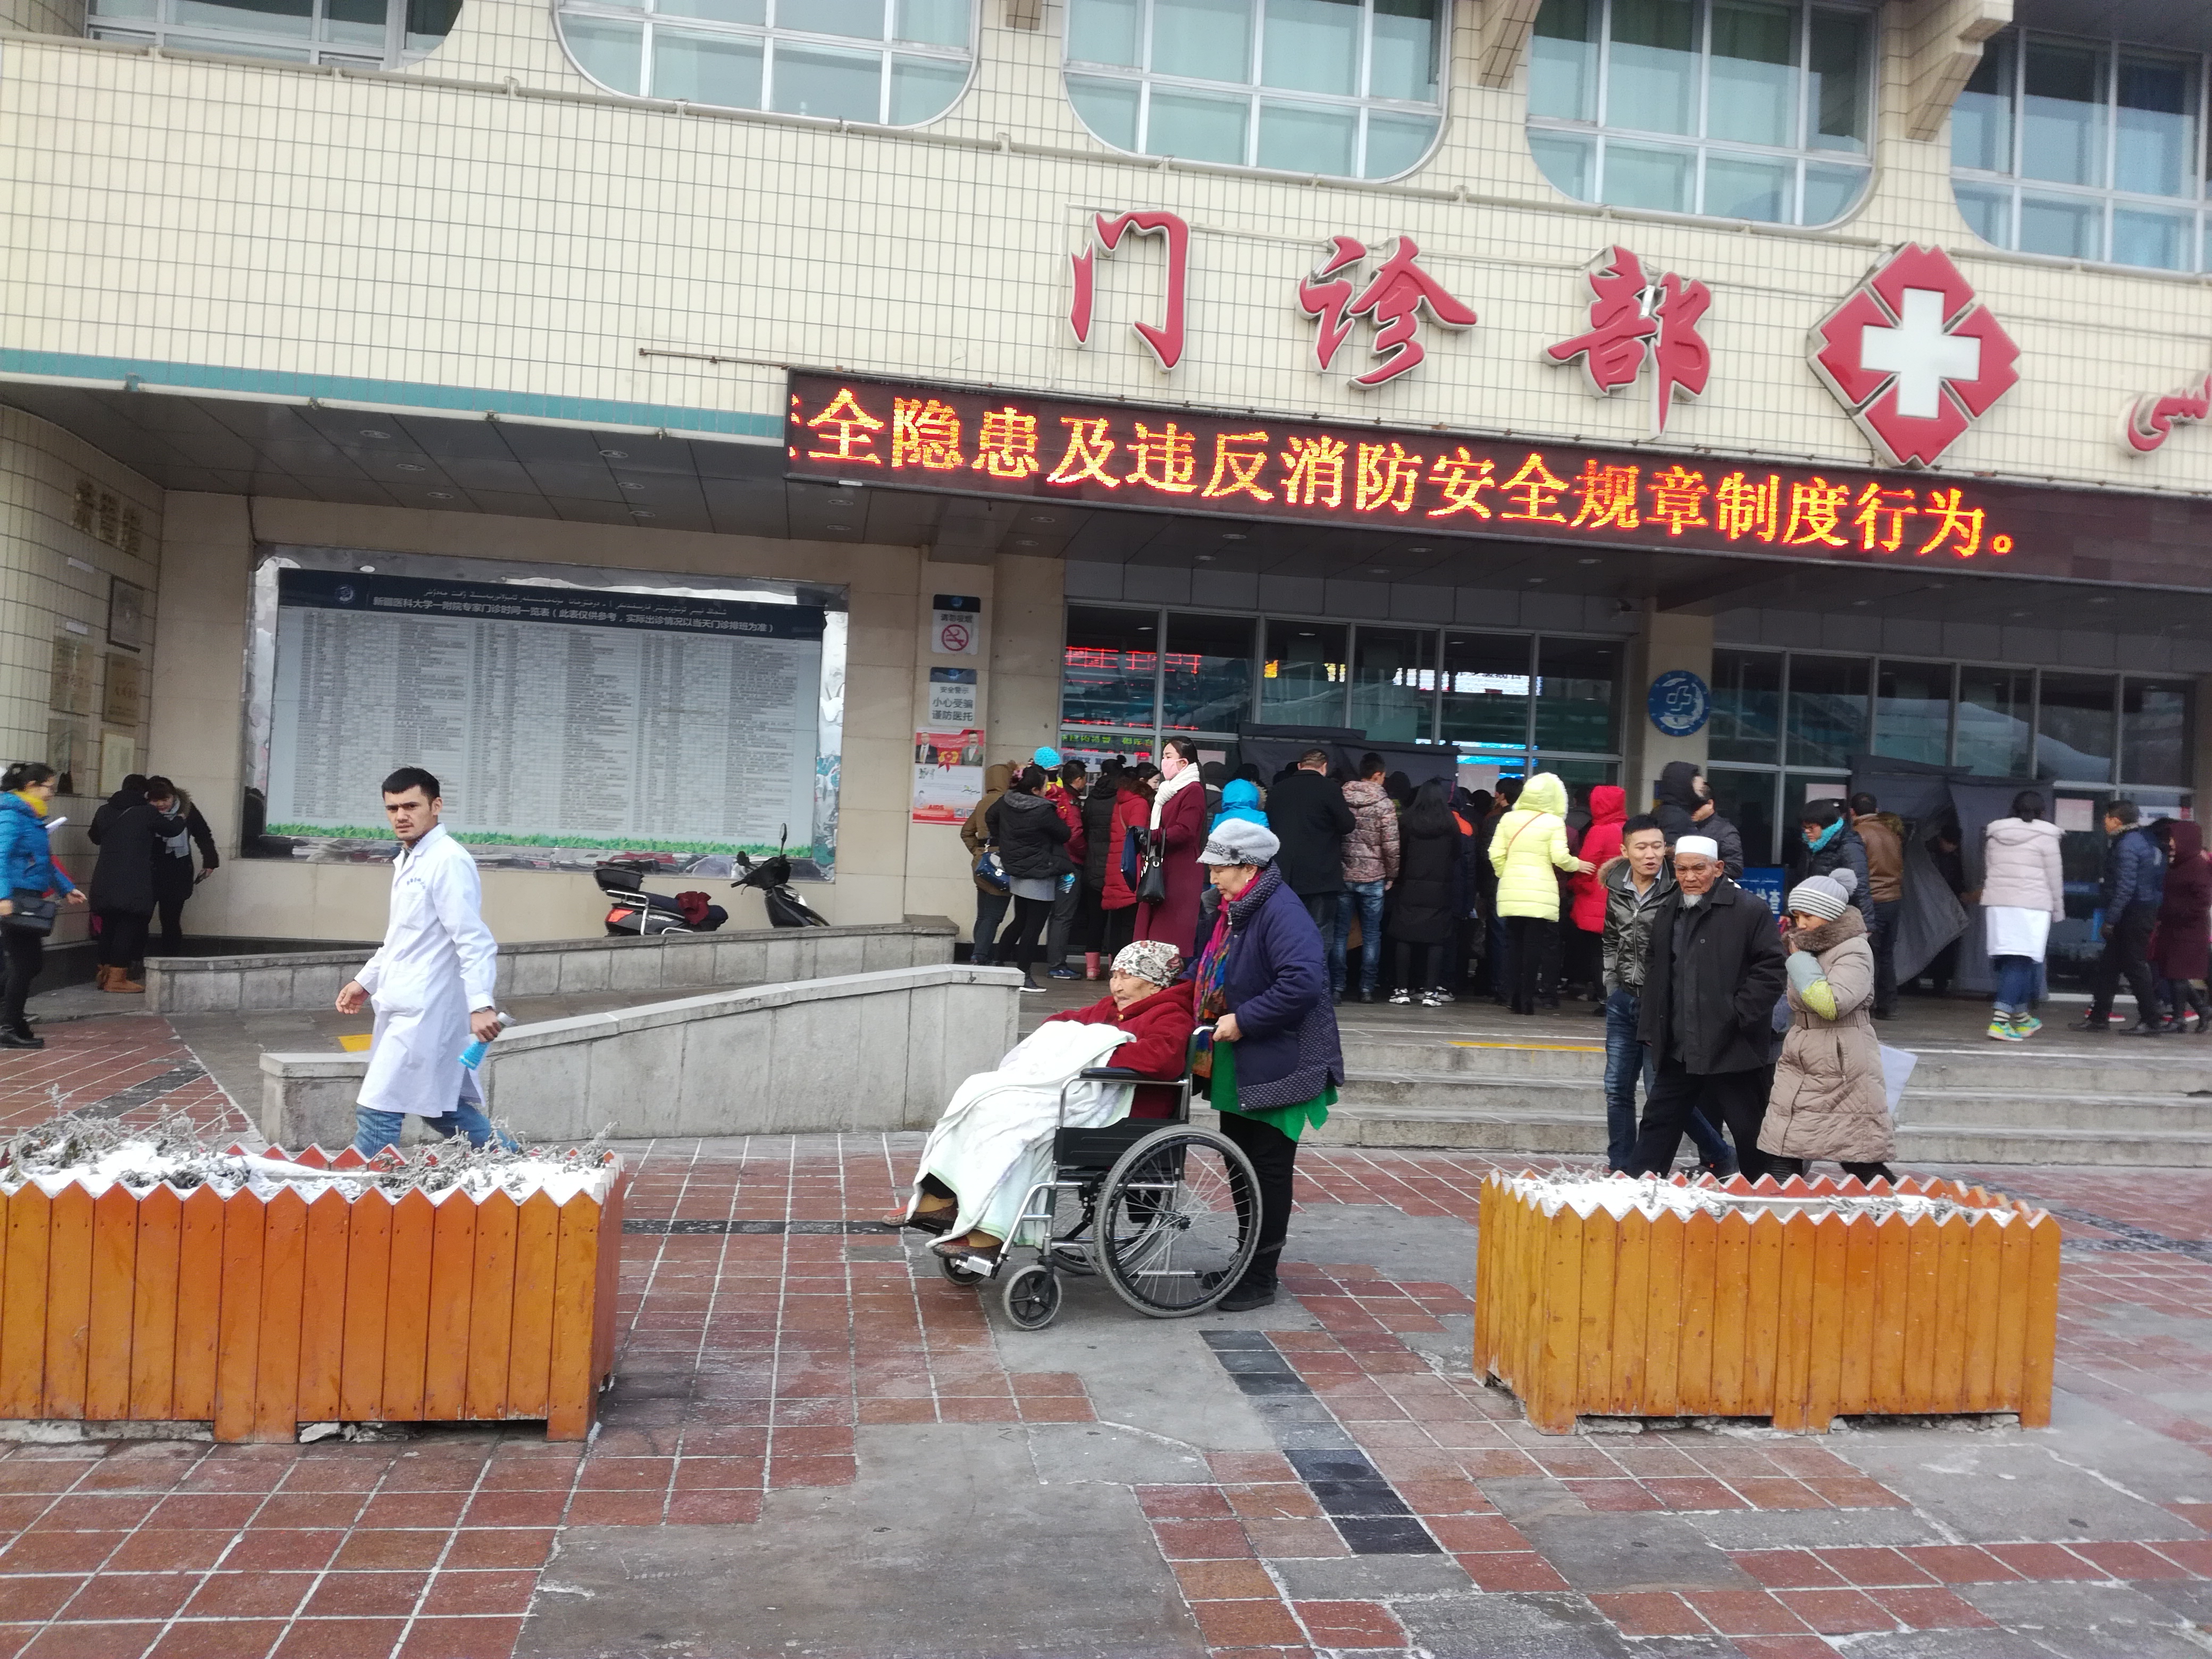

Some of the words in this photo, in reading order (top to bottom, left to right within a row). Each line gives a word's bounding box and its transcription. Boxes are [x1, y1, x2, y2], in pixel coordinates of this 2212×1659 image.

[1069, 210, 1713, 439] 门诊部
[789, 389, 2013, 558] 全隐患及违反消防安全规章制度行为。
[940, 686, 969, 694] 安全警示
[932, 697, 974, 709] 小心受骗
[932, 710, 973, 722] 谨防医托
